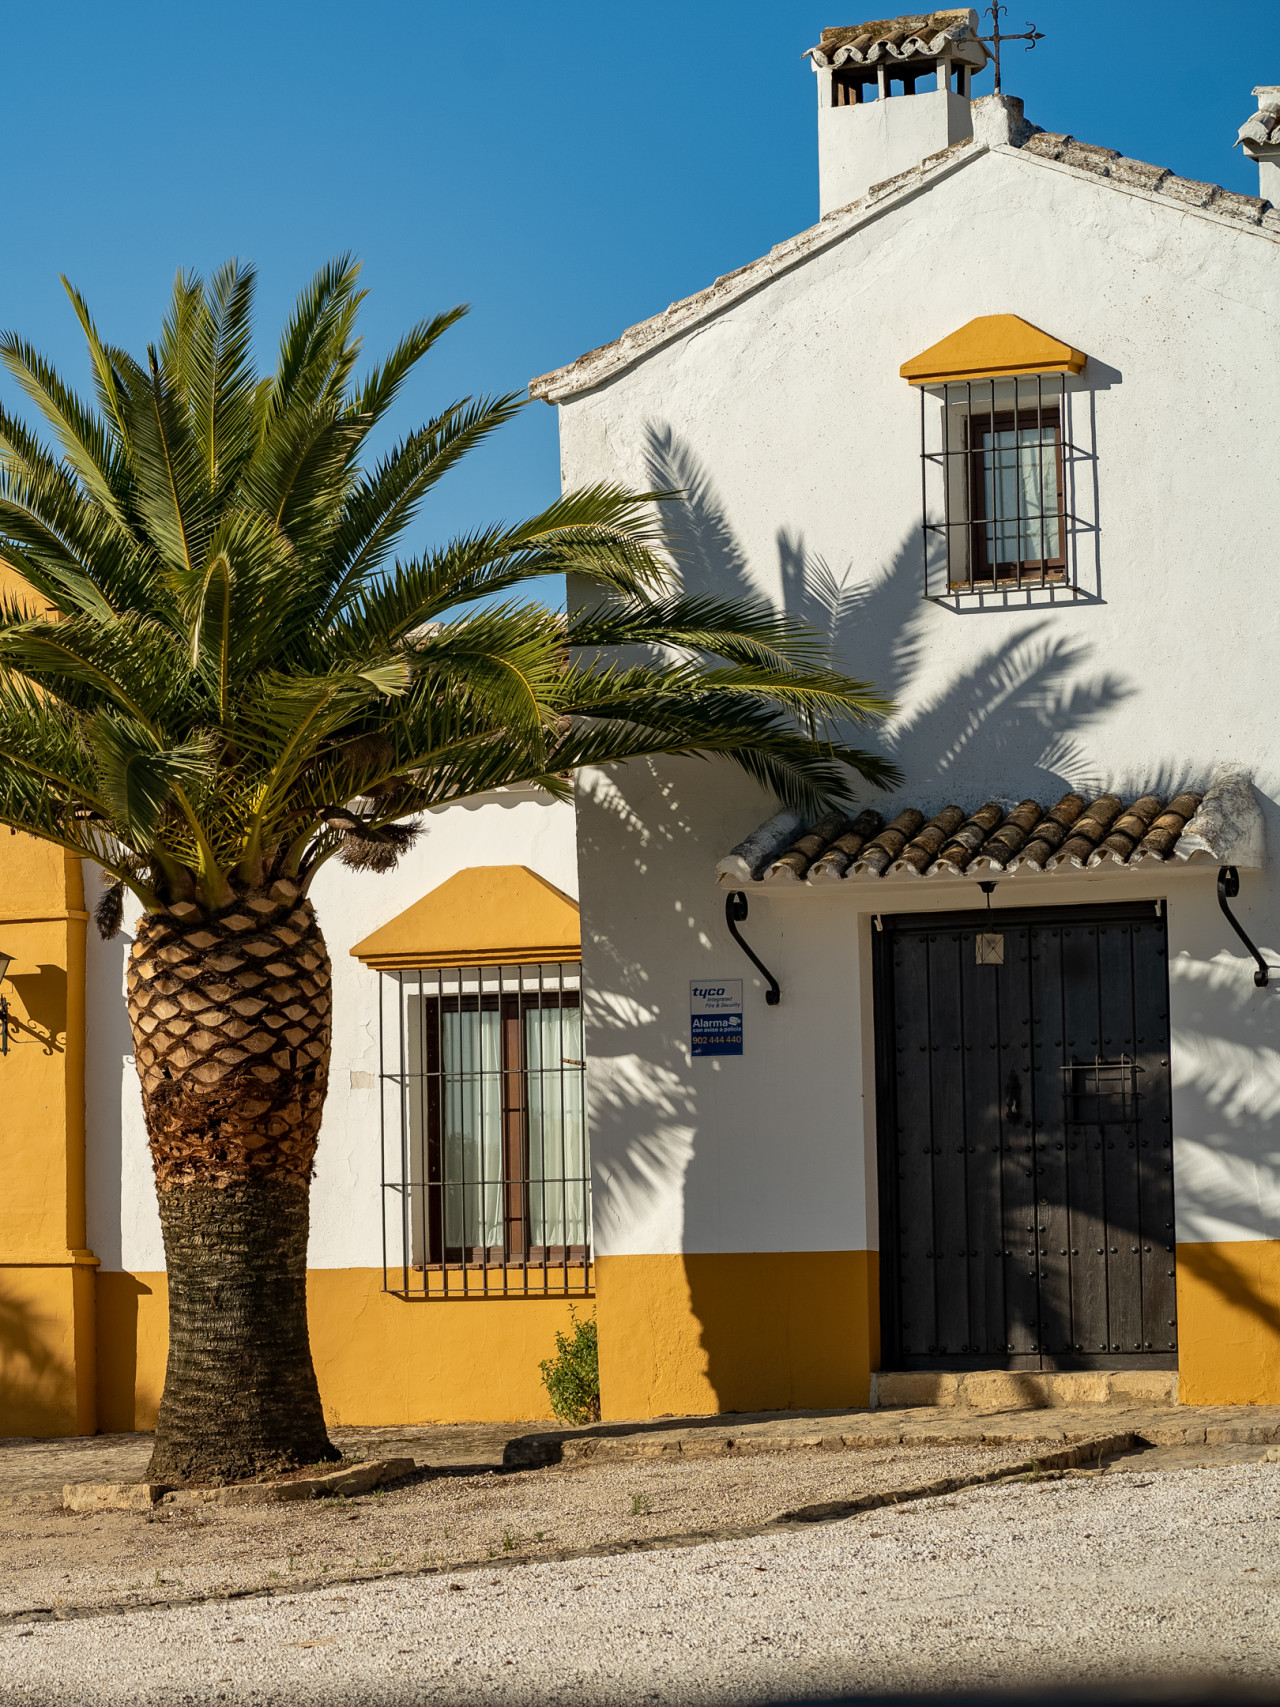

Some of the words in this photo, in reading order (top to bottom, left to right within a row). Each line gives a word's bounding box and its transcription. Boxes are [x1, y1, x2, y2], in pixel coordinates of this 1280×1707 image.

[692, 987, 725, 999] tyco
[693, 1018, 728, 1027] Alarma
[692, 1036, 708, 1045] 902
[709, 1036, 724, 1044] 444
[726, 1035, 742, 1043] 440
